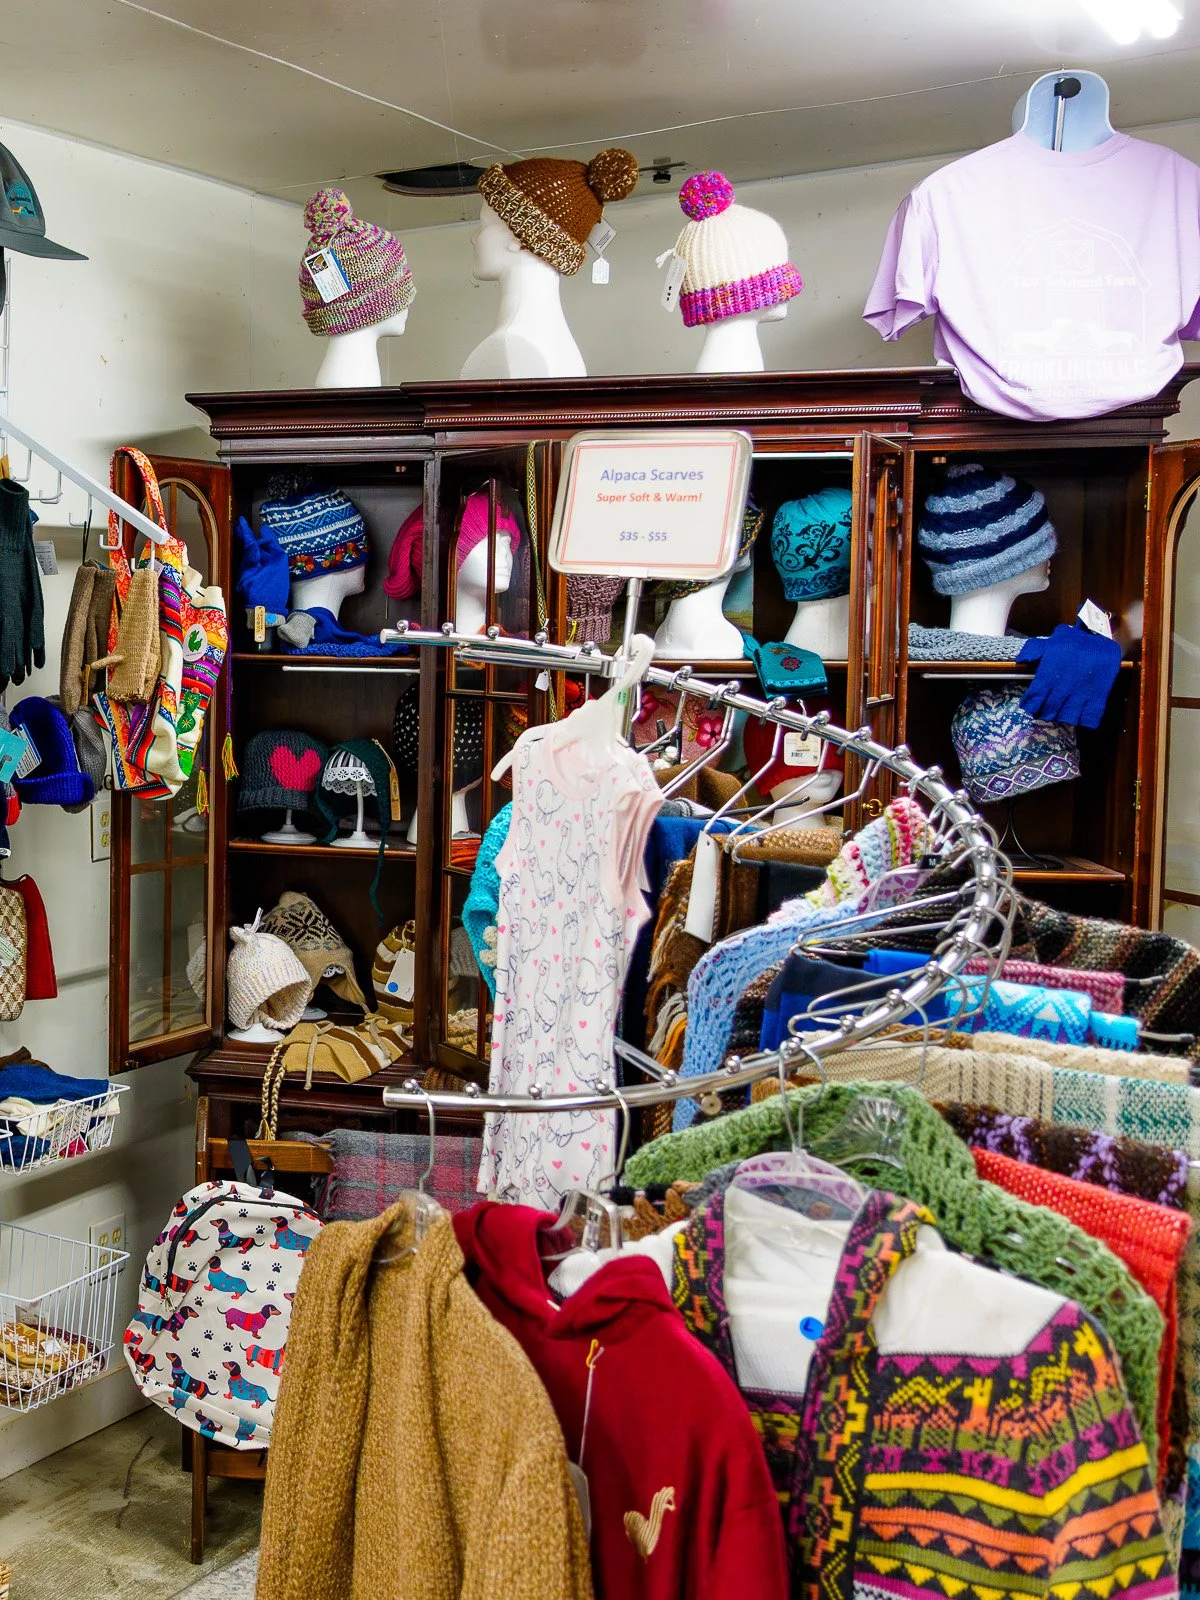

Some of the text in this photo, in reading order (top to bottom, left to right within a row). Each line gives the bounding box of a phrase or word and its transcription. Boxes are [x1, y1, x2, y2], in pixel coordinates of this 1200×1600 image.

[600, 469, 704, 484] Alpaca Scarves
[596, 492, 703, 504] Super Soft & Warm!
[619, 531, 639, 542] $35
[648, 531, 668, 542] $55
[929, 858, 936, 866] M
[803, 1318, 814, 1332] L
